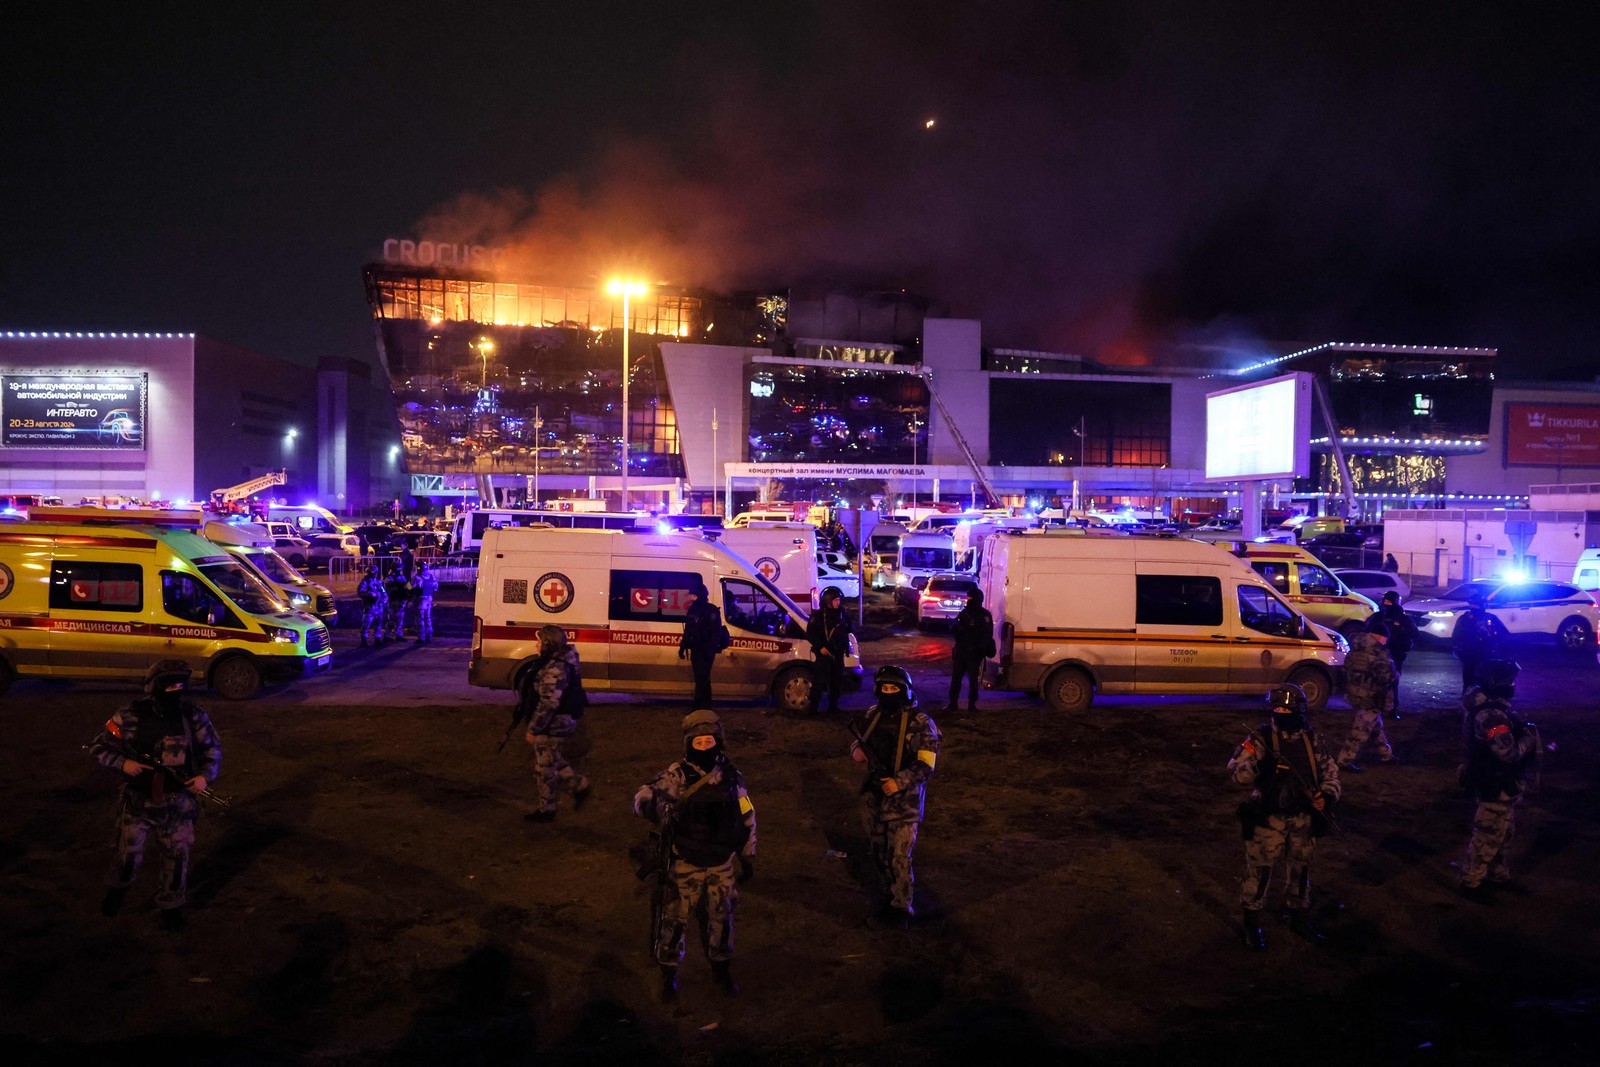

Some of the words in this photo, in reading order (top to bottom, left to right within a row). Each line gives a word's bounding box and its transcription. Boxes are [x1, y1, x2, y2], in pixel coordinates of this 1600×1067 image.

[383, 238, 487, 268] CROCUS
[28, 383, 96, 393] международная
[97, 383, 135, 391] выставка
[17, 391, 82, 400] автомобильной
[83, 392, 127, 401] индустрии
[46, 408, 98, 418] ИНТЕРАВТО
[9, 419, 35, 428] 20-23
[1548, 417, 1599, 428] TIKKURILA
[748, 467, 794, 475] концертный
[836, 467, 875, 475] МУСЛИМА
[54, 621, 132, 633] МЕДИЦИНСКАЯ
[171, 627, 217, 638] ПОМОЩЬ
[733, 640, 780, 651] ПОМОЩЬ
